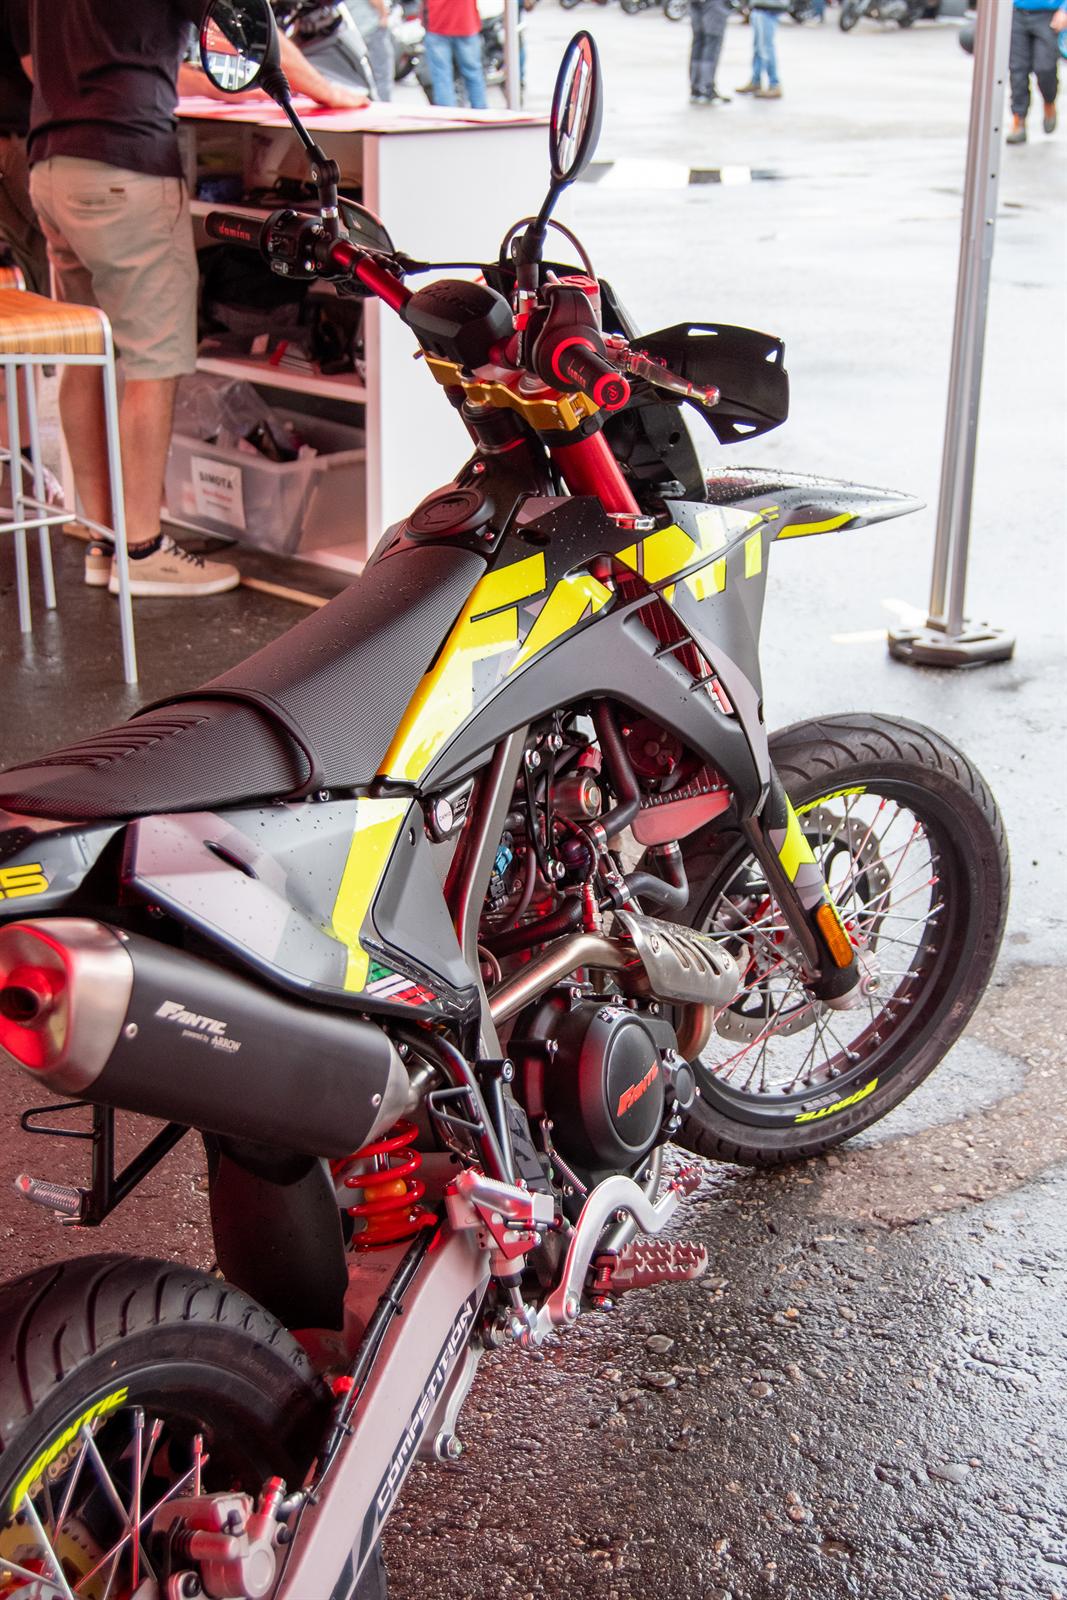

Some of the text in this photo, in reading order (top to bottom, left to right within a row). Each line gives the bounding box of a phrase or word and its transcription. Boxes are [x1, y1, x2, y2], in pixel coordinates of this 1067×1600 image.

[218, 220, 252, 241] domino
[794, 785, 867, 817] ANTIC
[154, 1000, 228, 1036] FANTIC
[794, 1077, 879, 1123] FANTIC
[377, 1300, 474, 1511] COMPETITION
[12, 1386, 129, 1513] FANTIC
